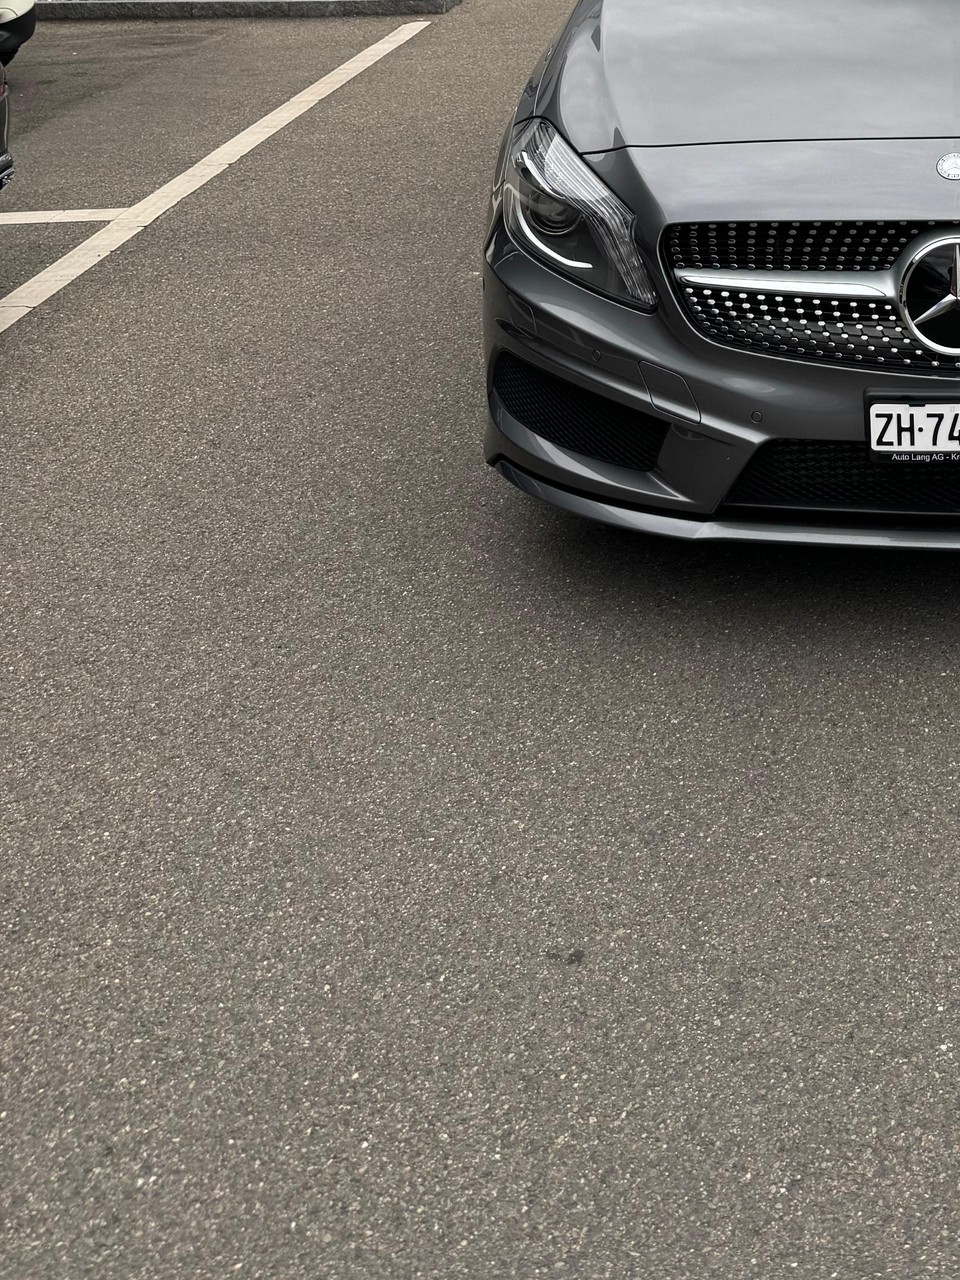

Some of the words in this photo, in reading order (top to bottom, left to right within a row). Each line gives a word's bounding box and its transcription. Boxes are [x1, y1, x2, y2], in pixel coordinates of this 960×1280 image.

[892, 453, 910, 461] Auto
[912, 453, 930, 463] Lang
[932, 452, 944, 461] AG
